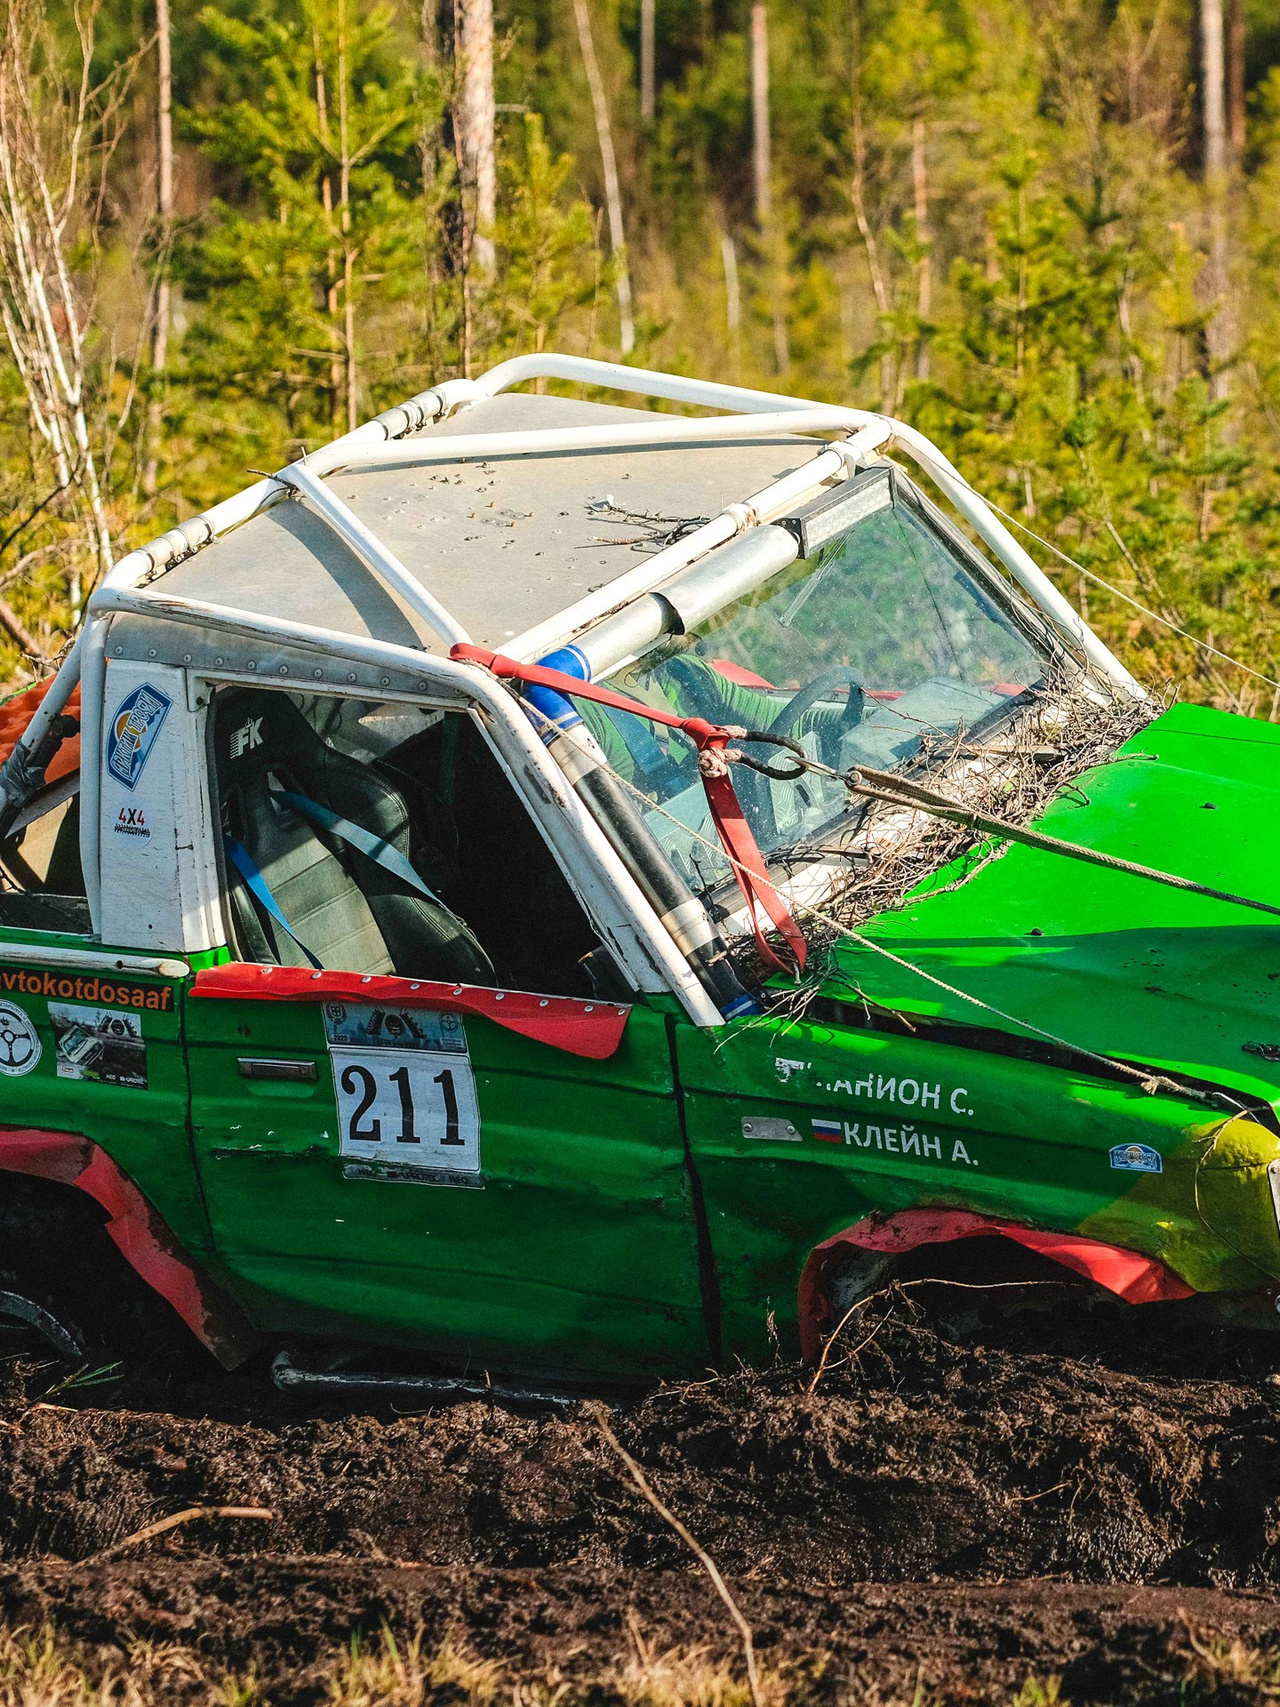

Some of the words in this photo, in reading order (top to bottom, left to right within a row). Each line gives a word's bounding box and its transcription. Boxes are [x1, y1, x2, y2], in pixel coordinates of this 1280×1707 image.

[230, 716, 264, 759] FK
[0, 970, 173, 1010] vtokotdosaaf
[341, 1064, 466, 1146] 211
[950, 1087, 974, 1116] С.
[843, 1121, 942, 1159] КЛЕЙН
[951, 1140, 979, 1166] А.
